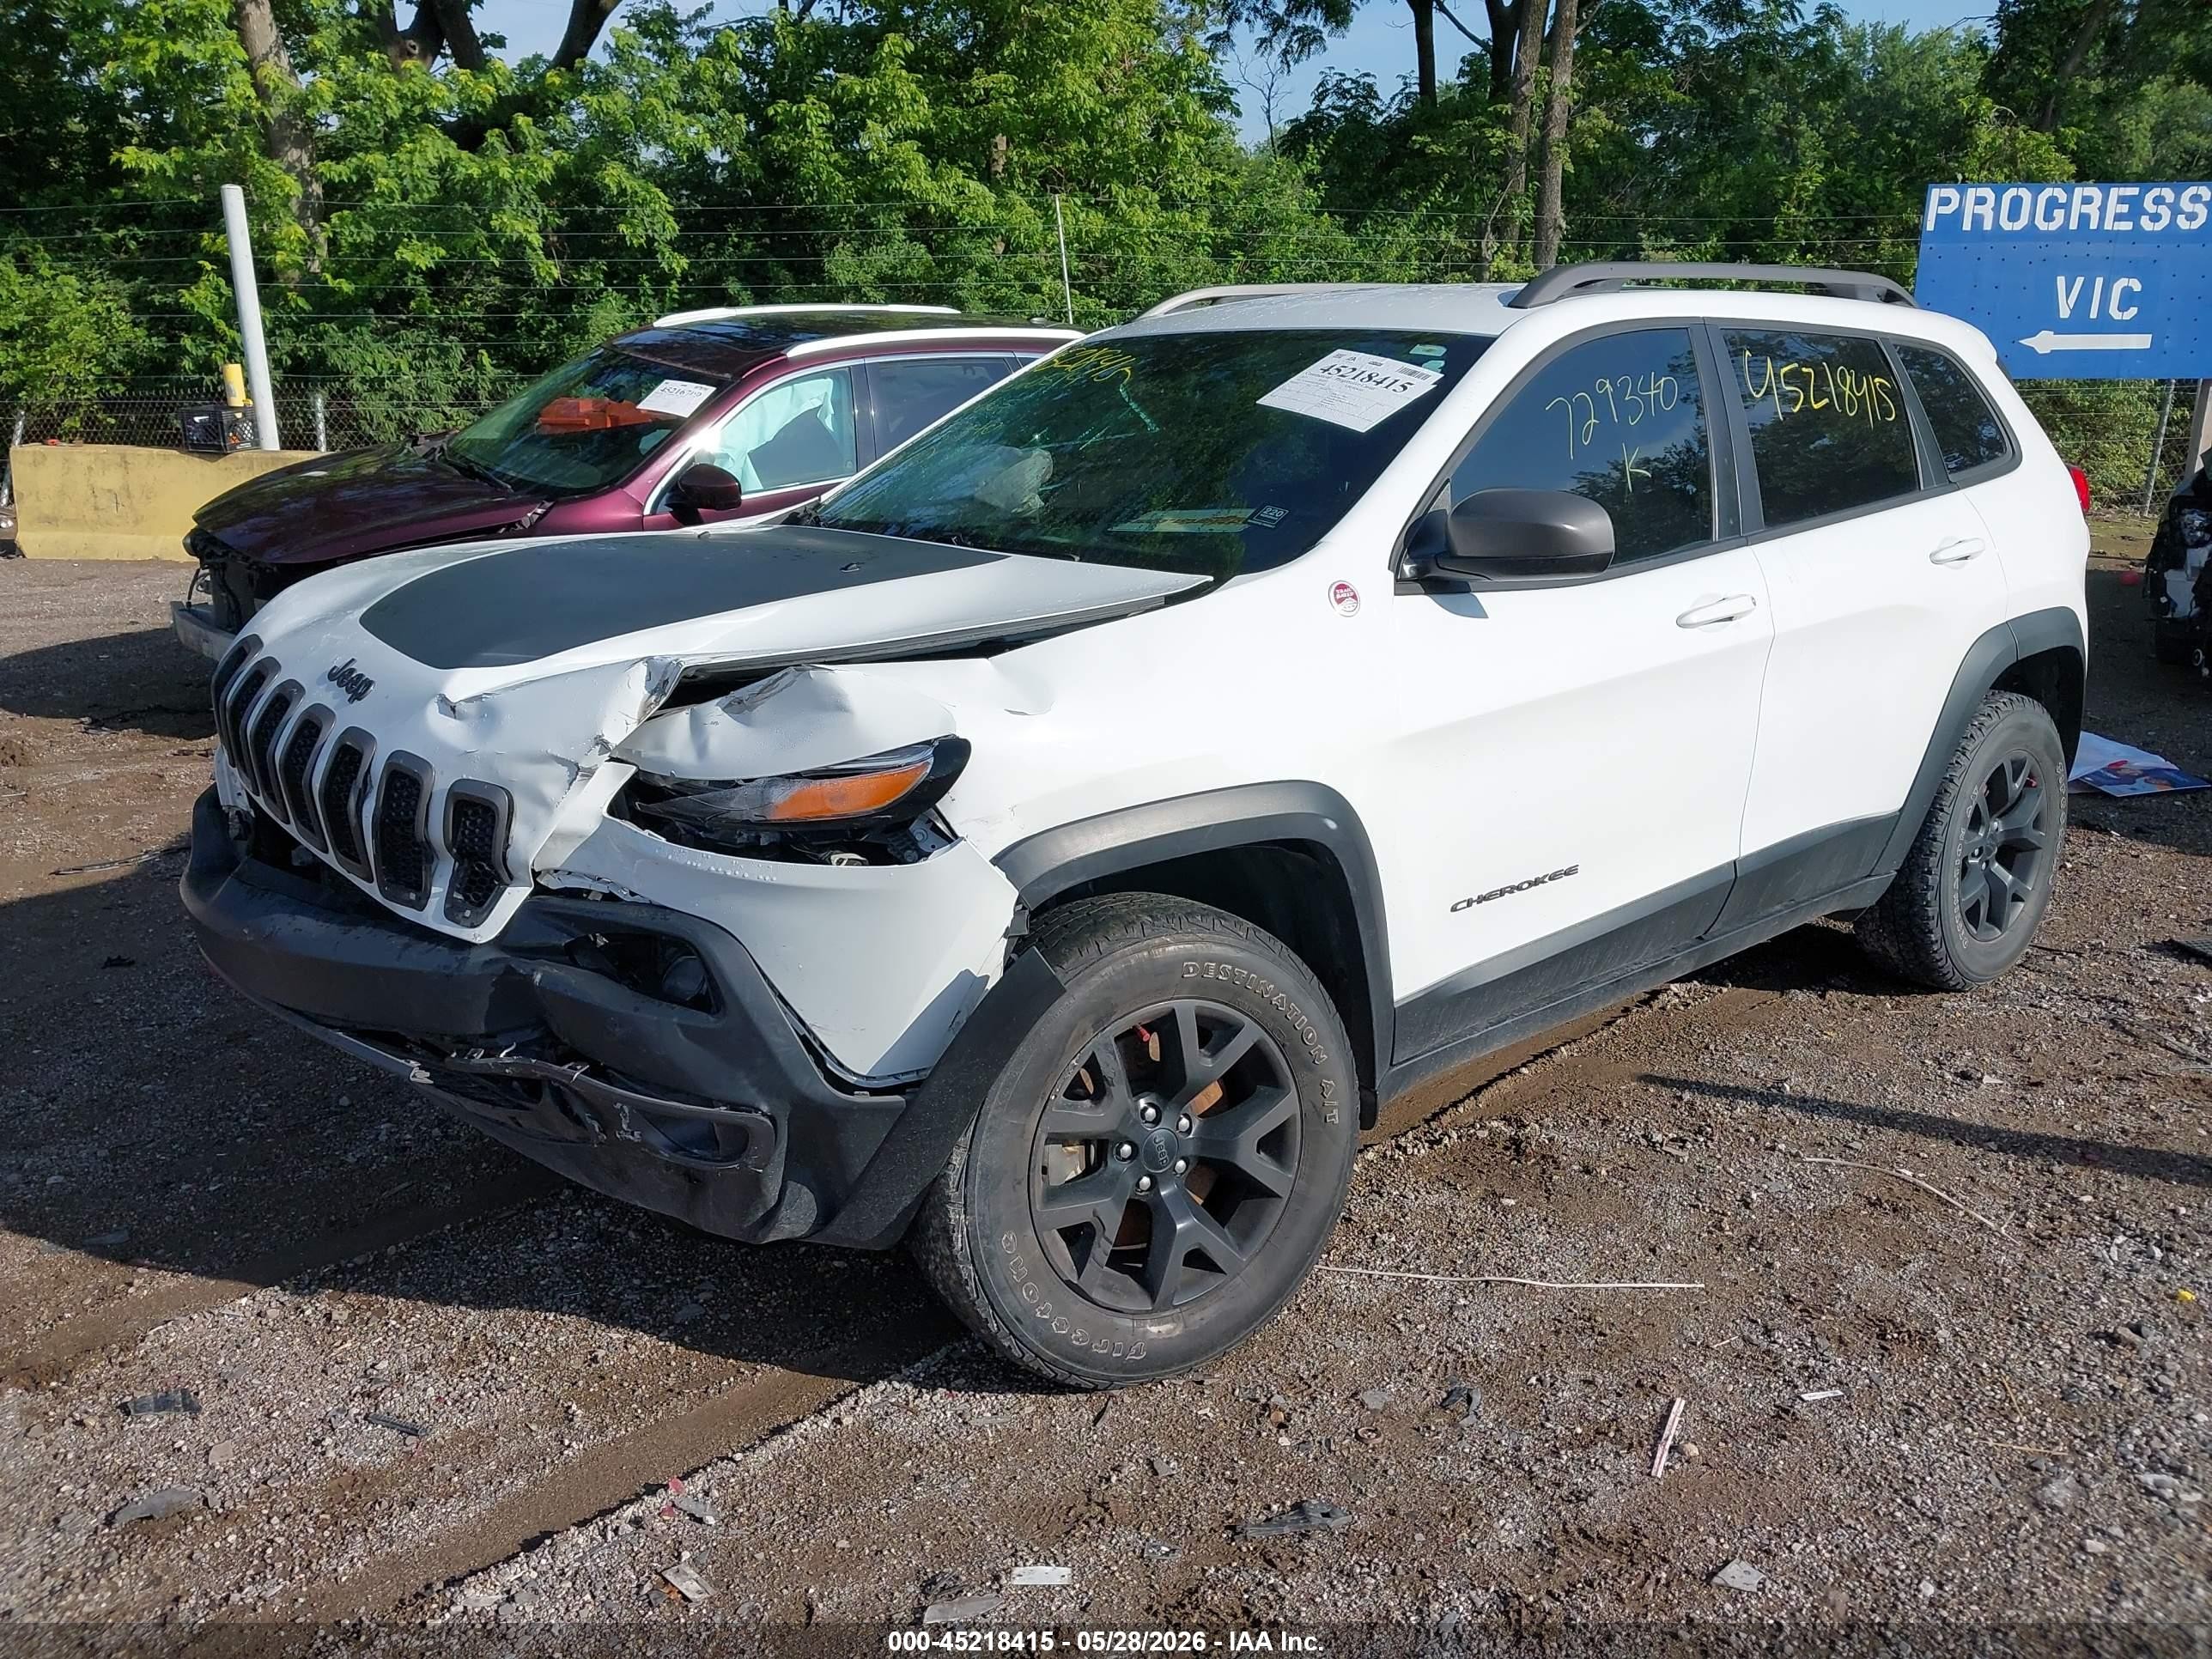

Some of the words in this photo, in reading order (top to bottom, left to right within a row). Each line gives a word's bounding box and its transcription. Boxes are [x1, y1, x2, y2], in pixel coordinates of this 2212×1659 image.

[1926, 185, 2212, 231] PROGRESS
[2057, 276, 2142, 320] VIC
[1319, 362, 1416, 393] 45218415
[1743, 349, 1896, 429] 45218415
[1546, 371, 1678, 460] 729340
[1621, 442, 1651, 493] K
[1263, 507, 1284, 517] 220
[327, 658, 375, 705] Jeep
[1450, 864, 1579, 913] CHEROKEE
[1182, 960, 1327, 1066] DESTINATION
[1153, 1133, 1171, 1166] Jeep
